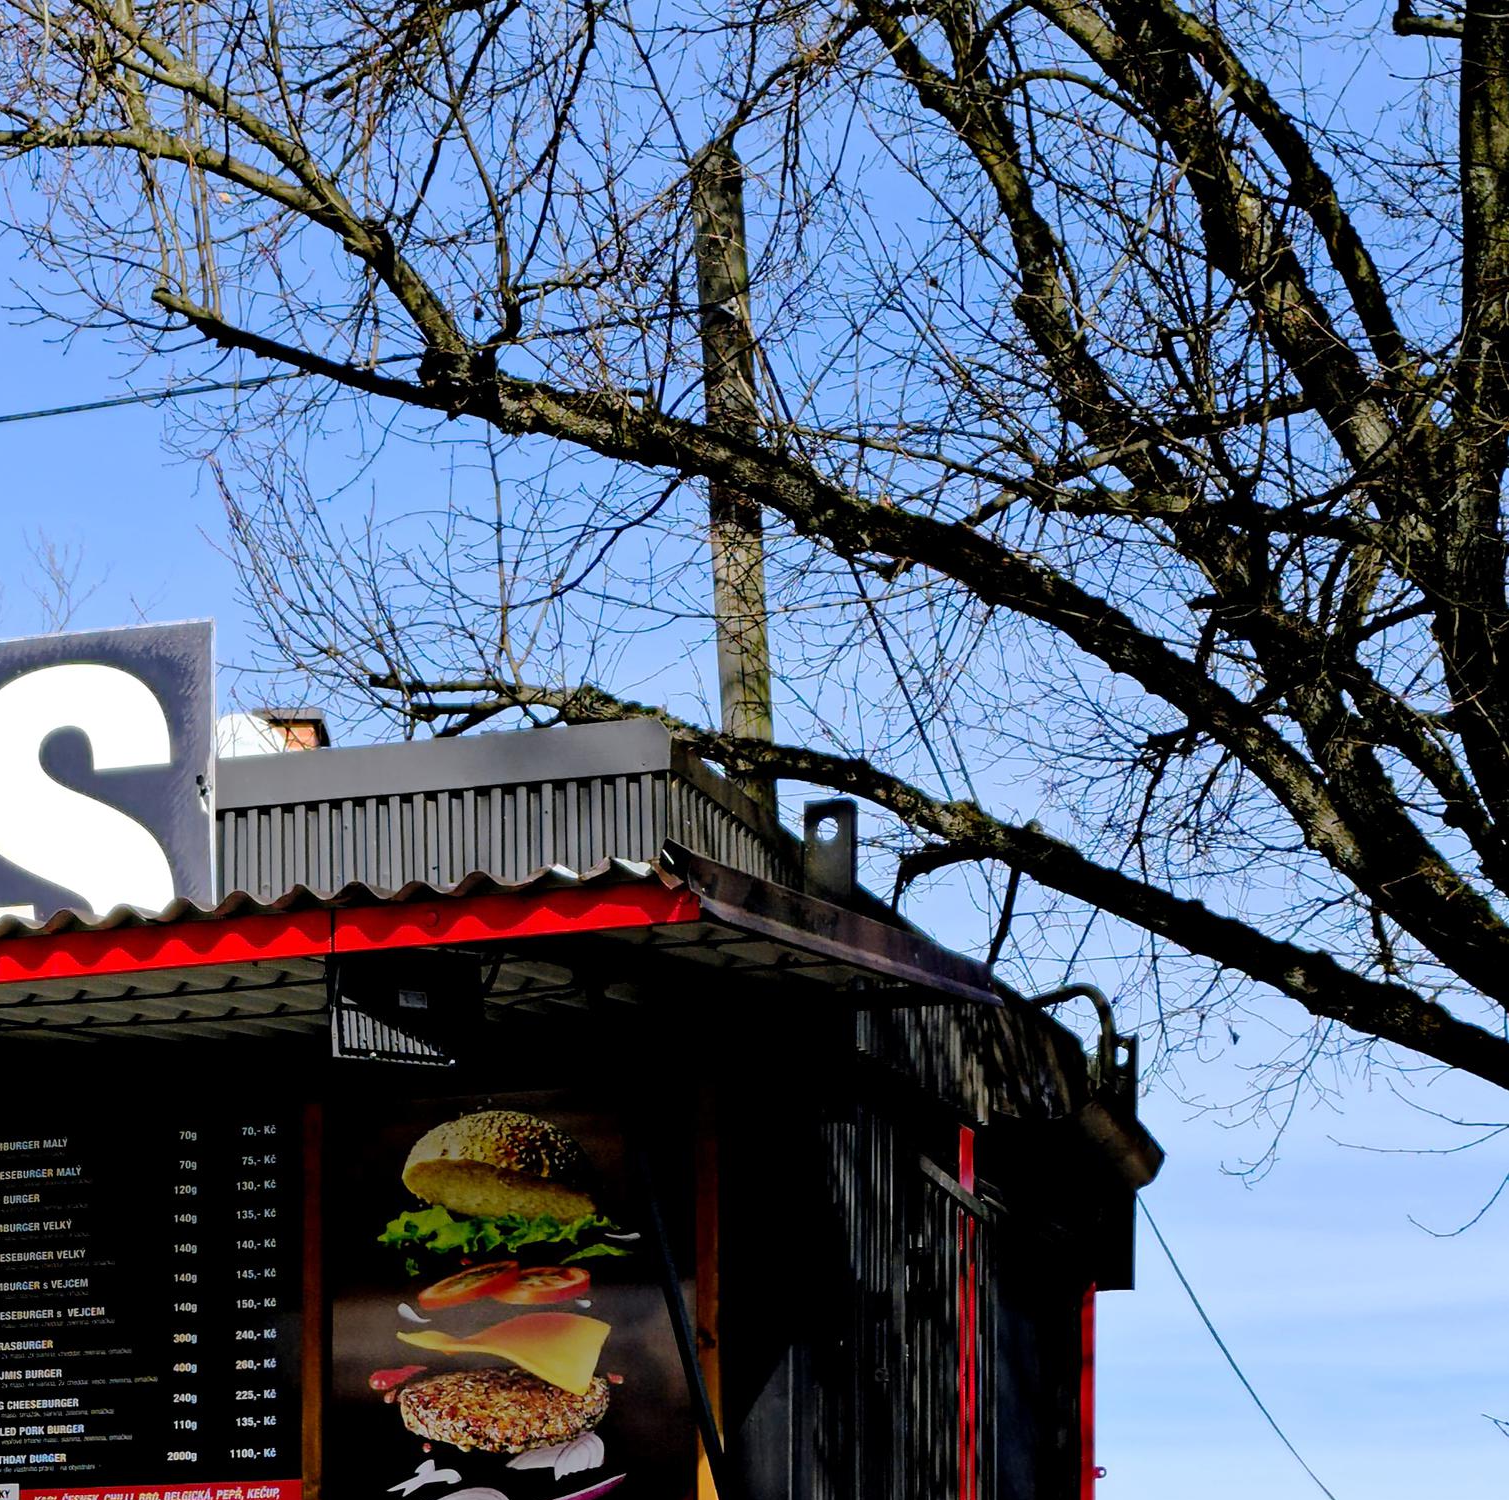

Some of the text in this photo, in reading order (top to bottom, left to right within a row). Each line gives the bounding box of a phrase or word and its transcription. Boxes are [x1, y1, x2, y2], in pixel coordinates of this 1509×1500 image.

[179, 1131, 197, 1141] 70g
[242, 1125, 276, 1136] 70,- Kč
[43, 1137, 67, 1148] MALÝ
[180, 1160, 197, 1170] 70g
[242, 1155, 276, 1166] 75,- Kč
[56, 1165, 81, 1176] MALÝ
[175, 1185, 197, 1195] 120g
[237, 1179, 276, 1190] 130,- Kč
[3, 1194, 40, 1204] BURGER
[174, 1214, 197, 1224] 140g
[237, 1208, 276, 1219] 135,- Kč
[43, 1219, 71, 1230] VELKÝ
[174, 1243, 197, 1254] 140g
[237, 1238, 276, 1249] 140,- Kč
[57, 1248, 85, 1259] VELKÝ
[174, 1273, 197, 1283] 140g
[237, 1268, 276, 1279] 145,- Kč
[51, 1278, 88, 1288] VEJCEM
[174, 1303, 197, 1313] 140g
[237, 1298, 276, 1309] 150,- Kč
[68, 1307, 104, 1317] VEJCEM
[174, 1333, 197, 1344] 300g
[236, 1329, 276, 1340] 240,- Kč
[173, 1363, 197, 1373] 400g
[264, 1358, 276, 1368] Kč
[25, 1369, 62, 1381] BURGER
[173, 1393, 197, 1404] 240g
[236, 1389, 276, 1400] 225,- Kč
[7, 1398, 79, 1410] CHEESEBURGER
[174, 1420, 197, 1431] 110g
[236, 1416, 276, 1427] 135,- Kč
[19, 1426, 44, 1435] PORK
[47, 1424, 84, 1434] BURGER
[30, 1453, 66, 1463] BURGER
[167, 1451, 197, 1462] 2000g
[230, 1448, 276, 1459] 1100,- Kč
